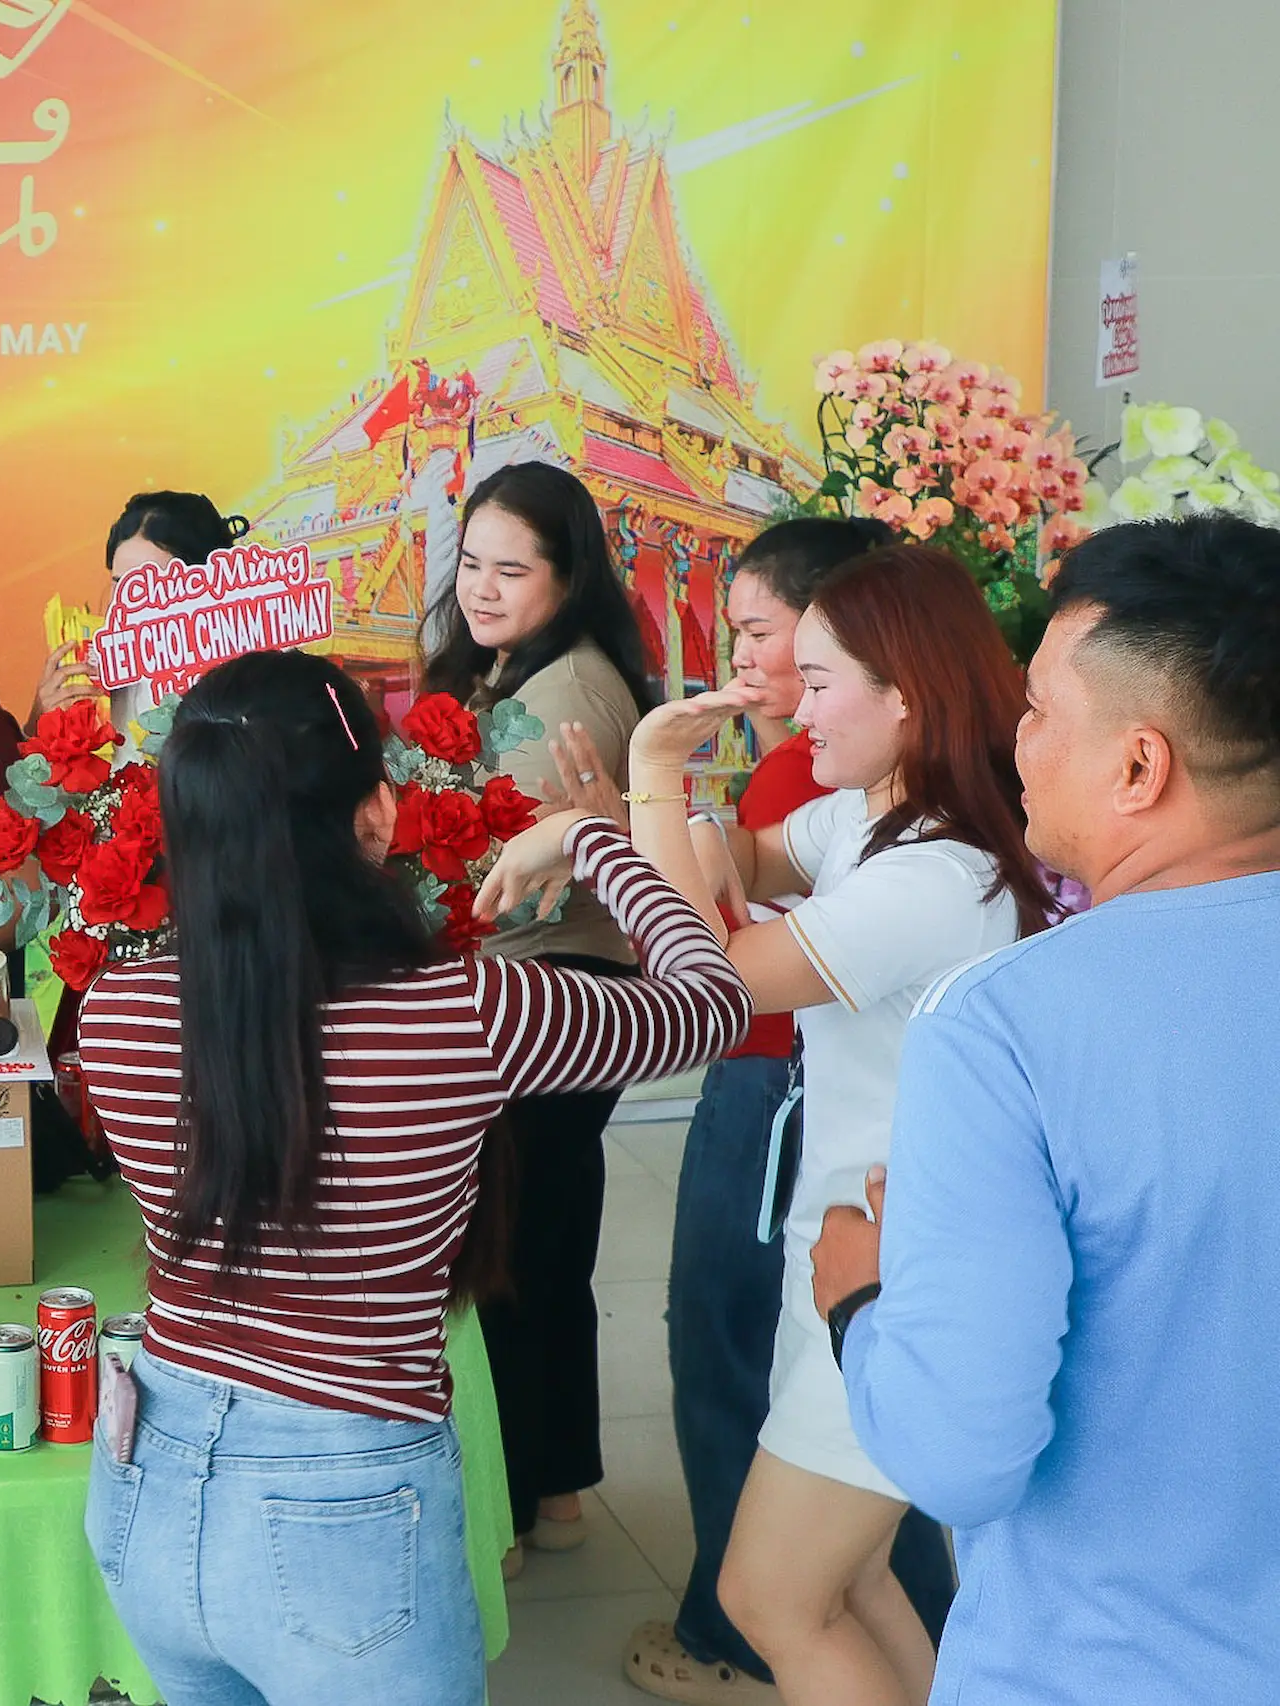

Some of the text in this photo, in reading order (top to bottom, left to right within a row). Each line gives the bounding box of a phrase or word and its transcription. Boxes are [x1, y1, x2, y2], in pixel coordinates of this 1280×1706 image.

[120, 547, 305, 609] Chúc Mừng
[101, 608, 138, 683] TẾT
[139, 617, 196, 673] CHOL
[193, 603, 266, 660] CHNAM
[265, 586, 328, 645] THMAY
